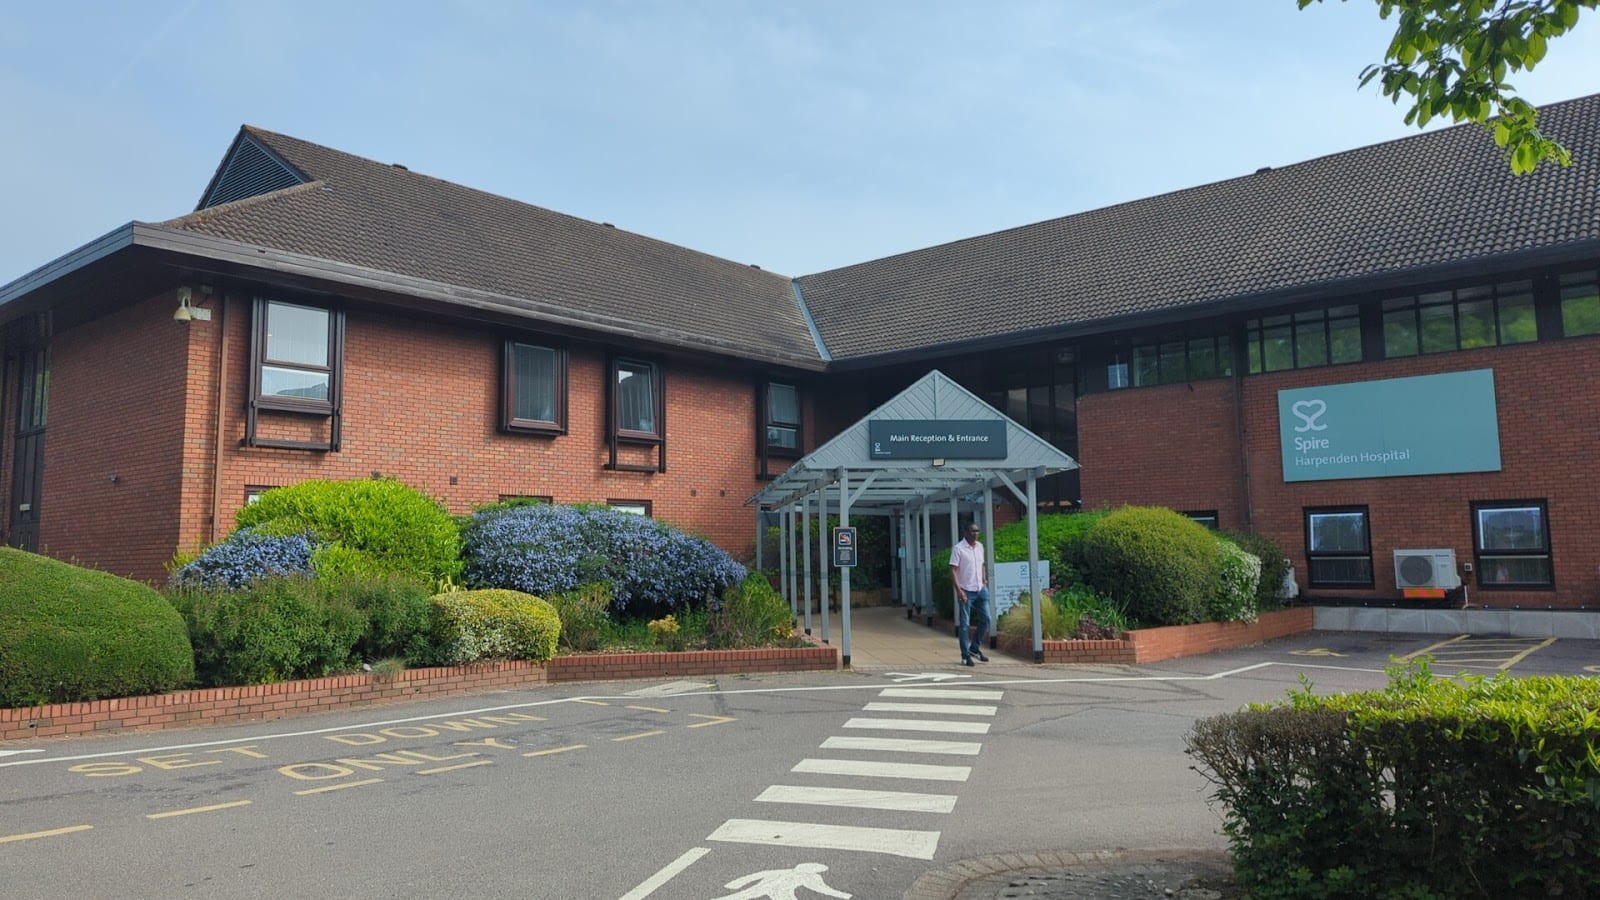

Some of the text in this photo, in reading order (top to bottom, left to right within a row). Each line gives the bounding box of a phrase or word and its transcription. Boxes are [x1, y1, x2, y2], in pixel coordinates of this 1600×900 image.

[890, 434, 989, 443] Main Reception & Entrance
[1294, 436, 1329, 453] Spire
[1295, 449, 1410, 467] Harpenden Hospital
[67, 712, 548, 777] SET DOWN
[277, 736, 517, 780] ONLY
